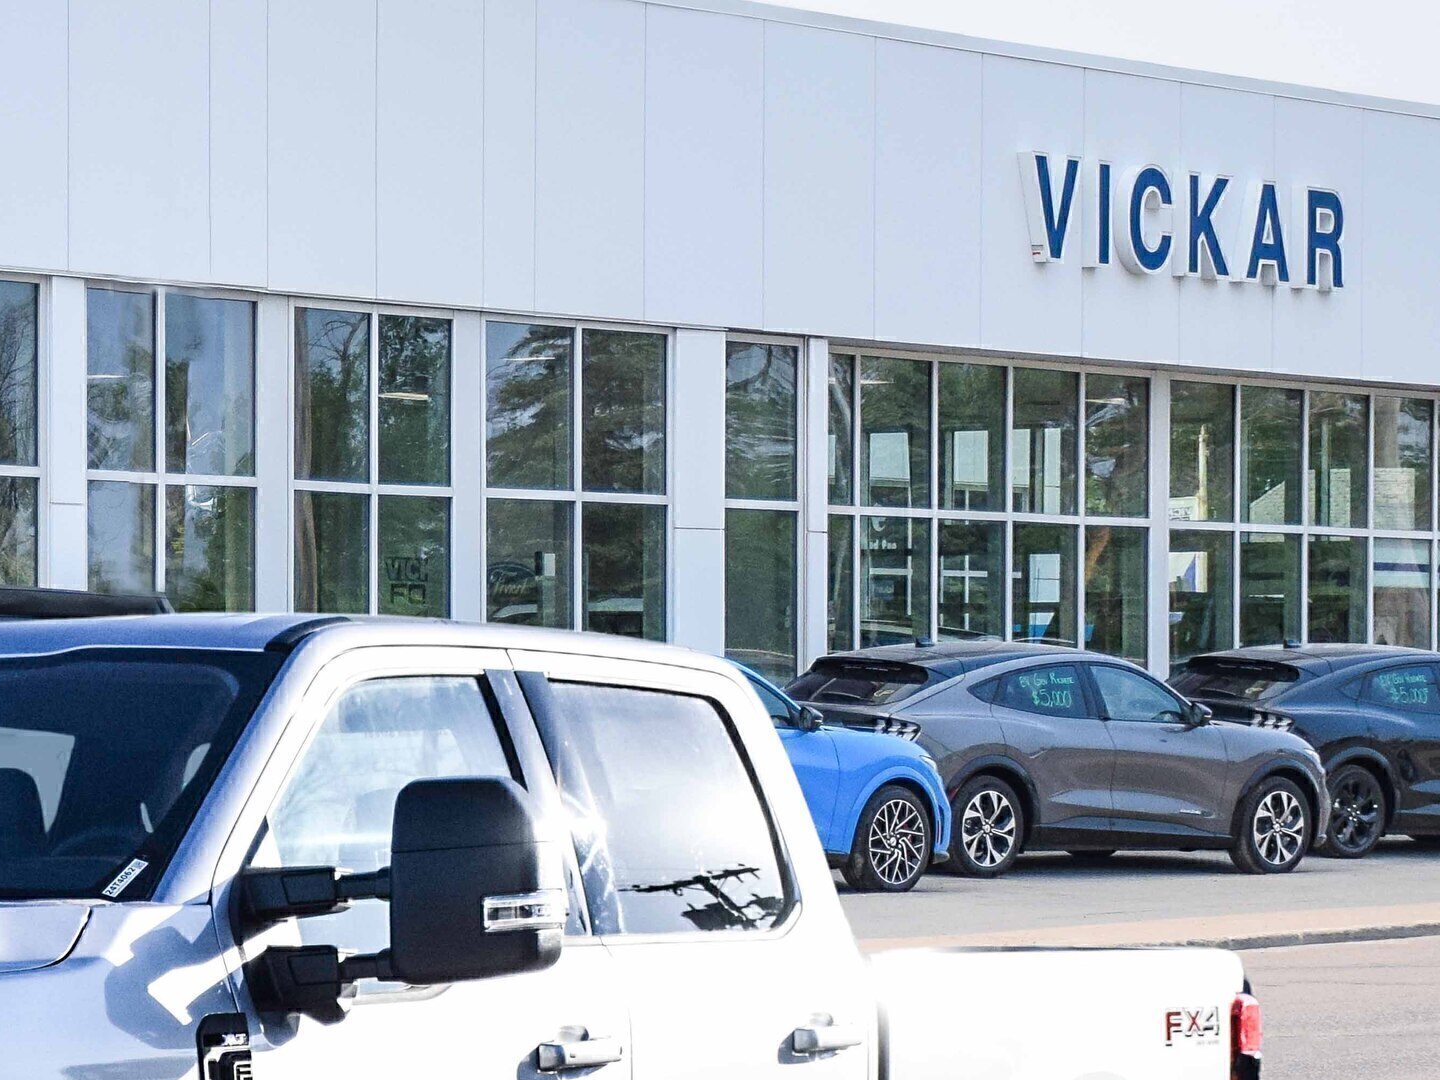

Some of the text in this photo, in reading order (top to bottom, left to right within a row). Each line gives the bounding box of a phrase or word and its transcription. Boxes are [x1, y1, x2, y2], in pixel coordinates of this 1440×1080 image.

[1028, 151, 1344, 290] VICKAR
[1032, 688, 1072, 708] $5,000
[105, 867, 136, 895] 24T4062
[1165, 1006, 1219, 1043] FX4
